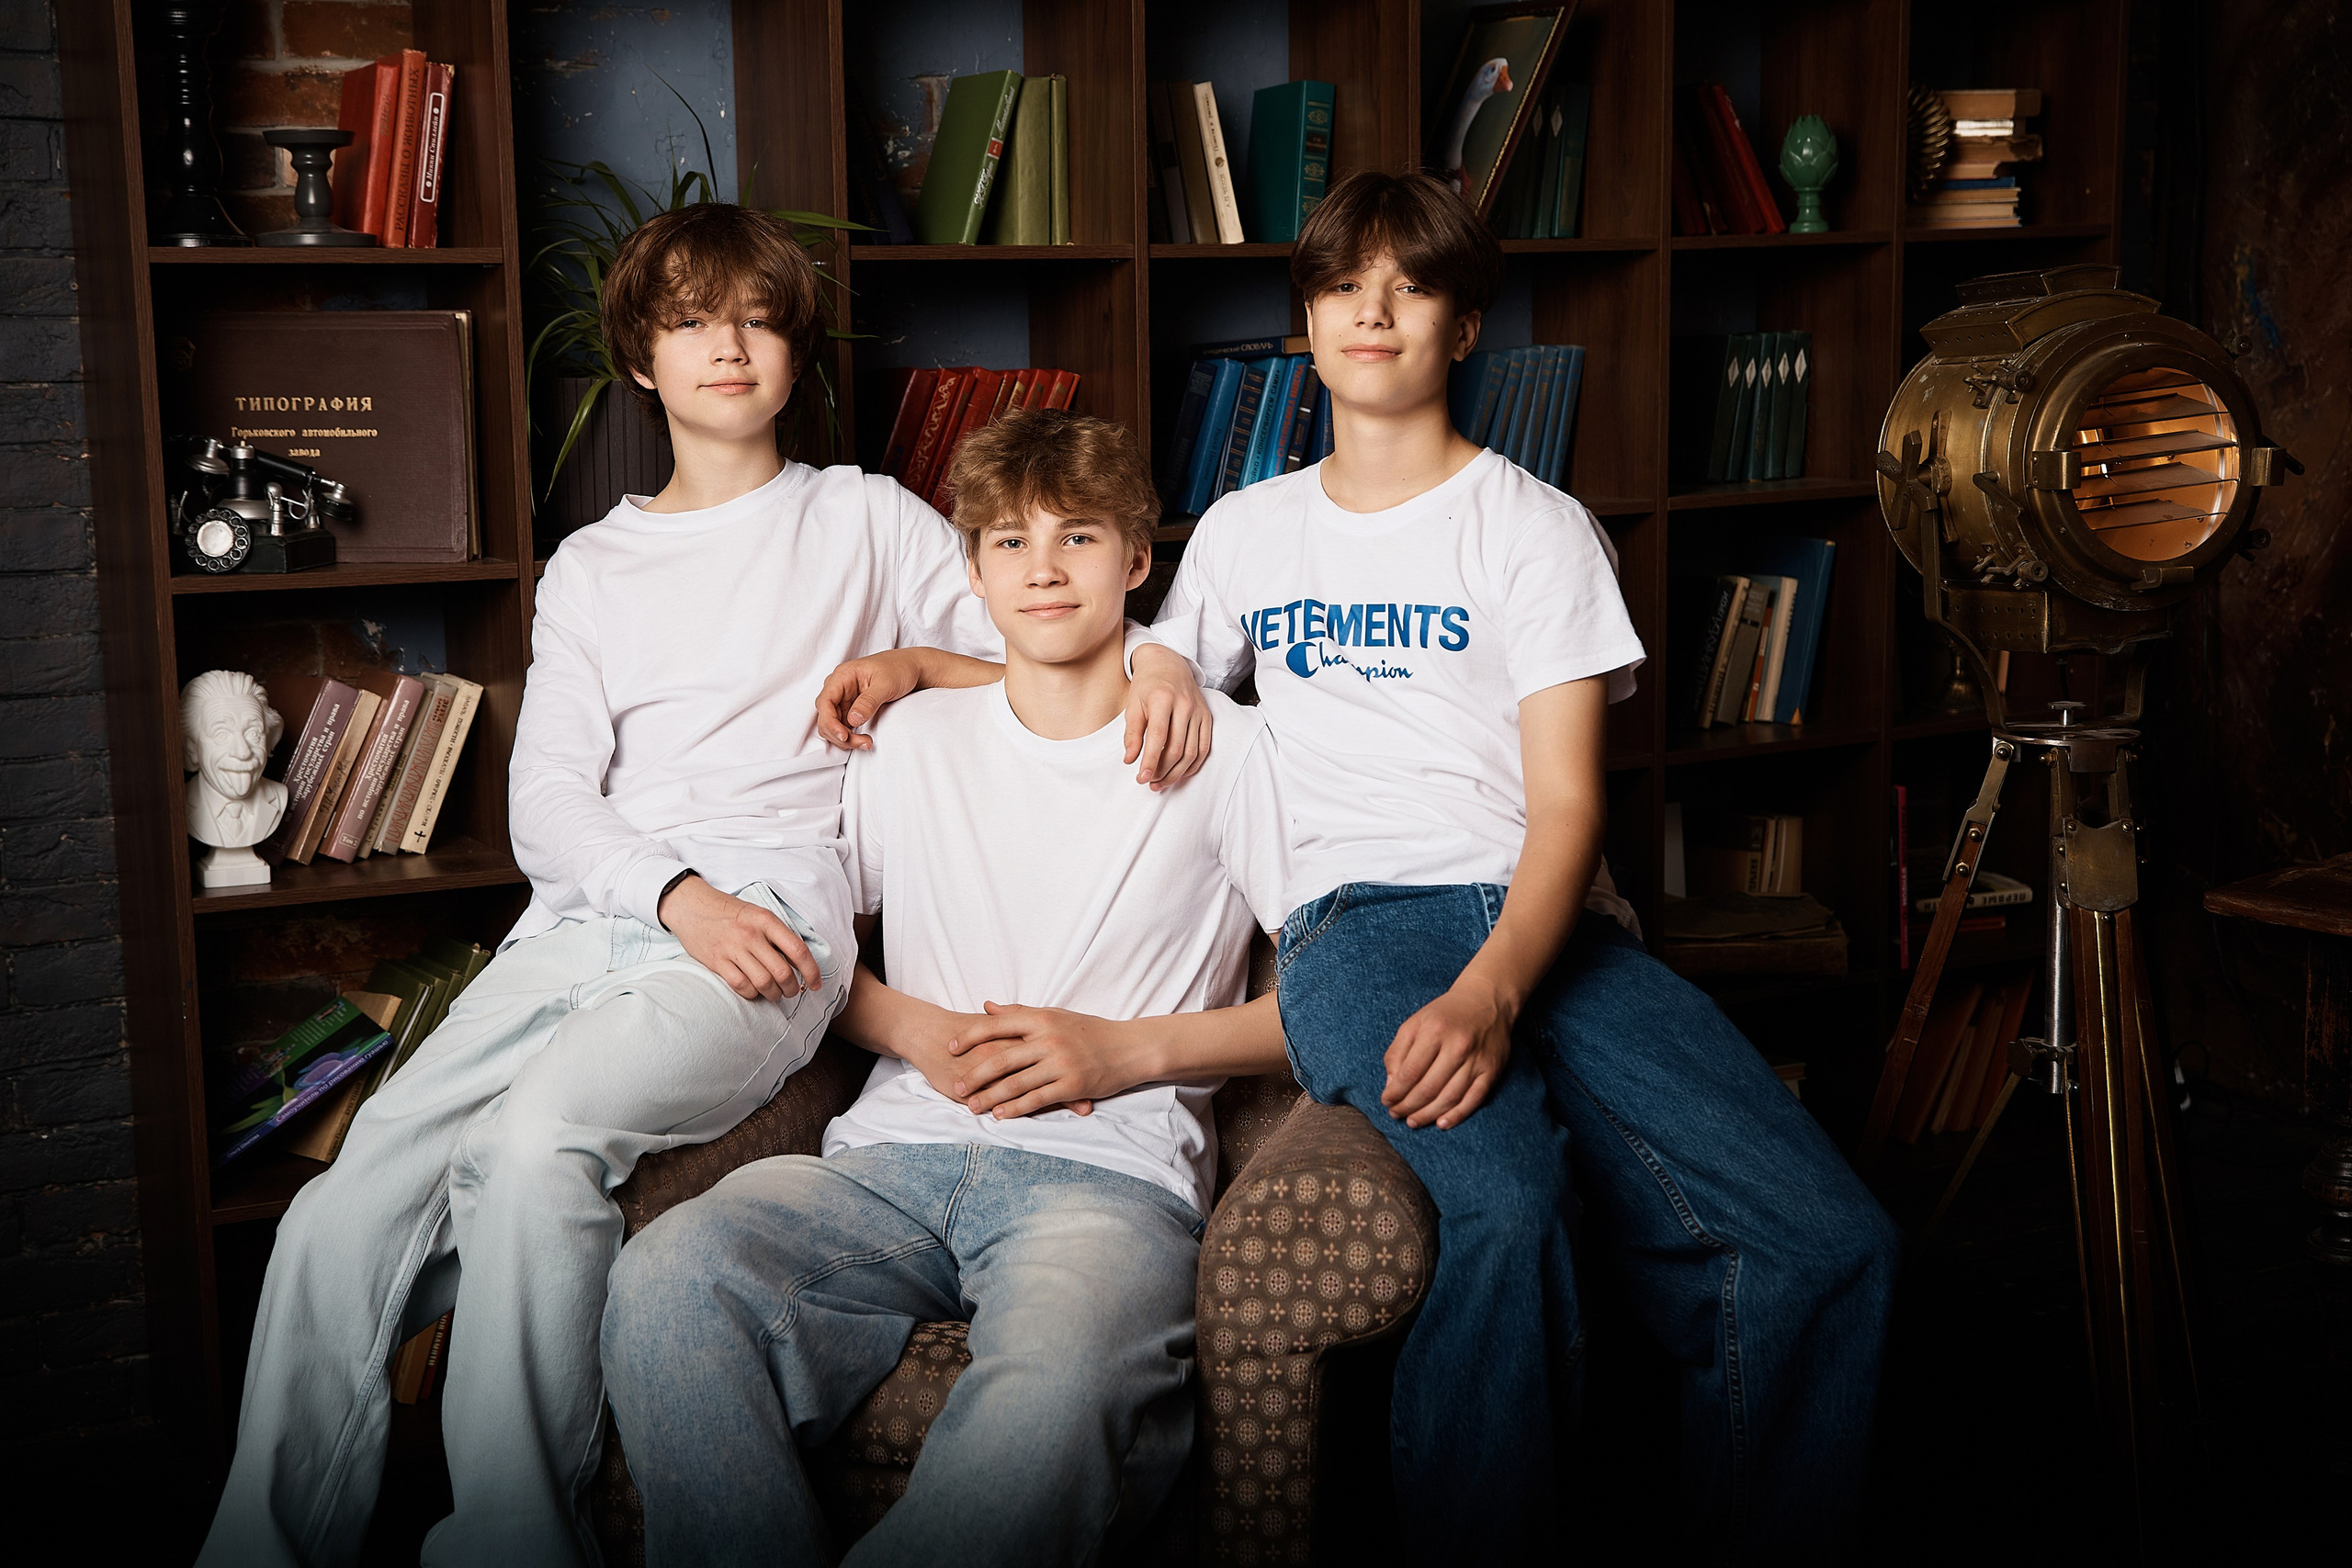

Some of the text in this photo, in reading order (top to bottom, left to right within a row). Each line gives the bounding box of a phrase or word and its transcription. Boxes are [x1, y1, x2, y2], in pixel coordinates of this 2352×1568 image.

[394, 67, 418, 231] РАССКАЗЫ О ЖИВОТНЫХ
[425, 115, 438, 180] Микки Спиллейн
[232, 425, 379, 439] Горьковского автомобильного
[234, 396, 374, 412] ТИПОГРАФИЯ
[1257, 397, 1273, 454] КОНСЕРВИРУЕМ
[1270, 373, 1280, 394] САМИ
[288, 446, 322, 459] завода
[1240, 599, 1470, 651] VETEMENTS
[288, 780, 306, 811] истории
[302, 734, 326, 779] государства
[326, 703, 340, 726] права
[292, 736, 318, 784] Хрестоматия
[300, 730, 335, 800] зарубежных стран
[356, 808, 365, 819] по
[362, 777, 379, 807] истории
[374, 730, 397, 775] государства
[396, 698, 410, 721] права
[364, 732, 389, 781] Хрестоматия
[372, 726, 405, 796] зарубежных стран
[341, 835, 353, 844] Том
[276, 1089, 319, 1122] Самоучитель
[318, 1083, 328, 1092] по
[328, 1056, 365, 1086] рисованию
[364, 1039, 389, 1060] гуашью
